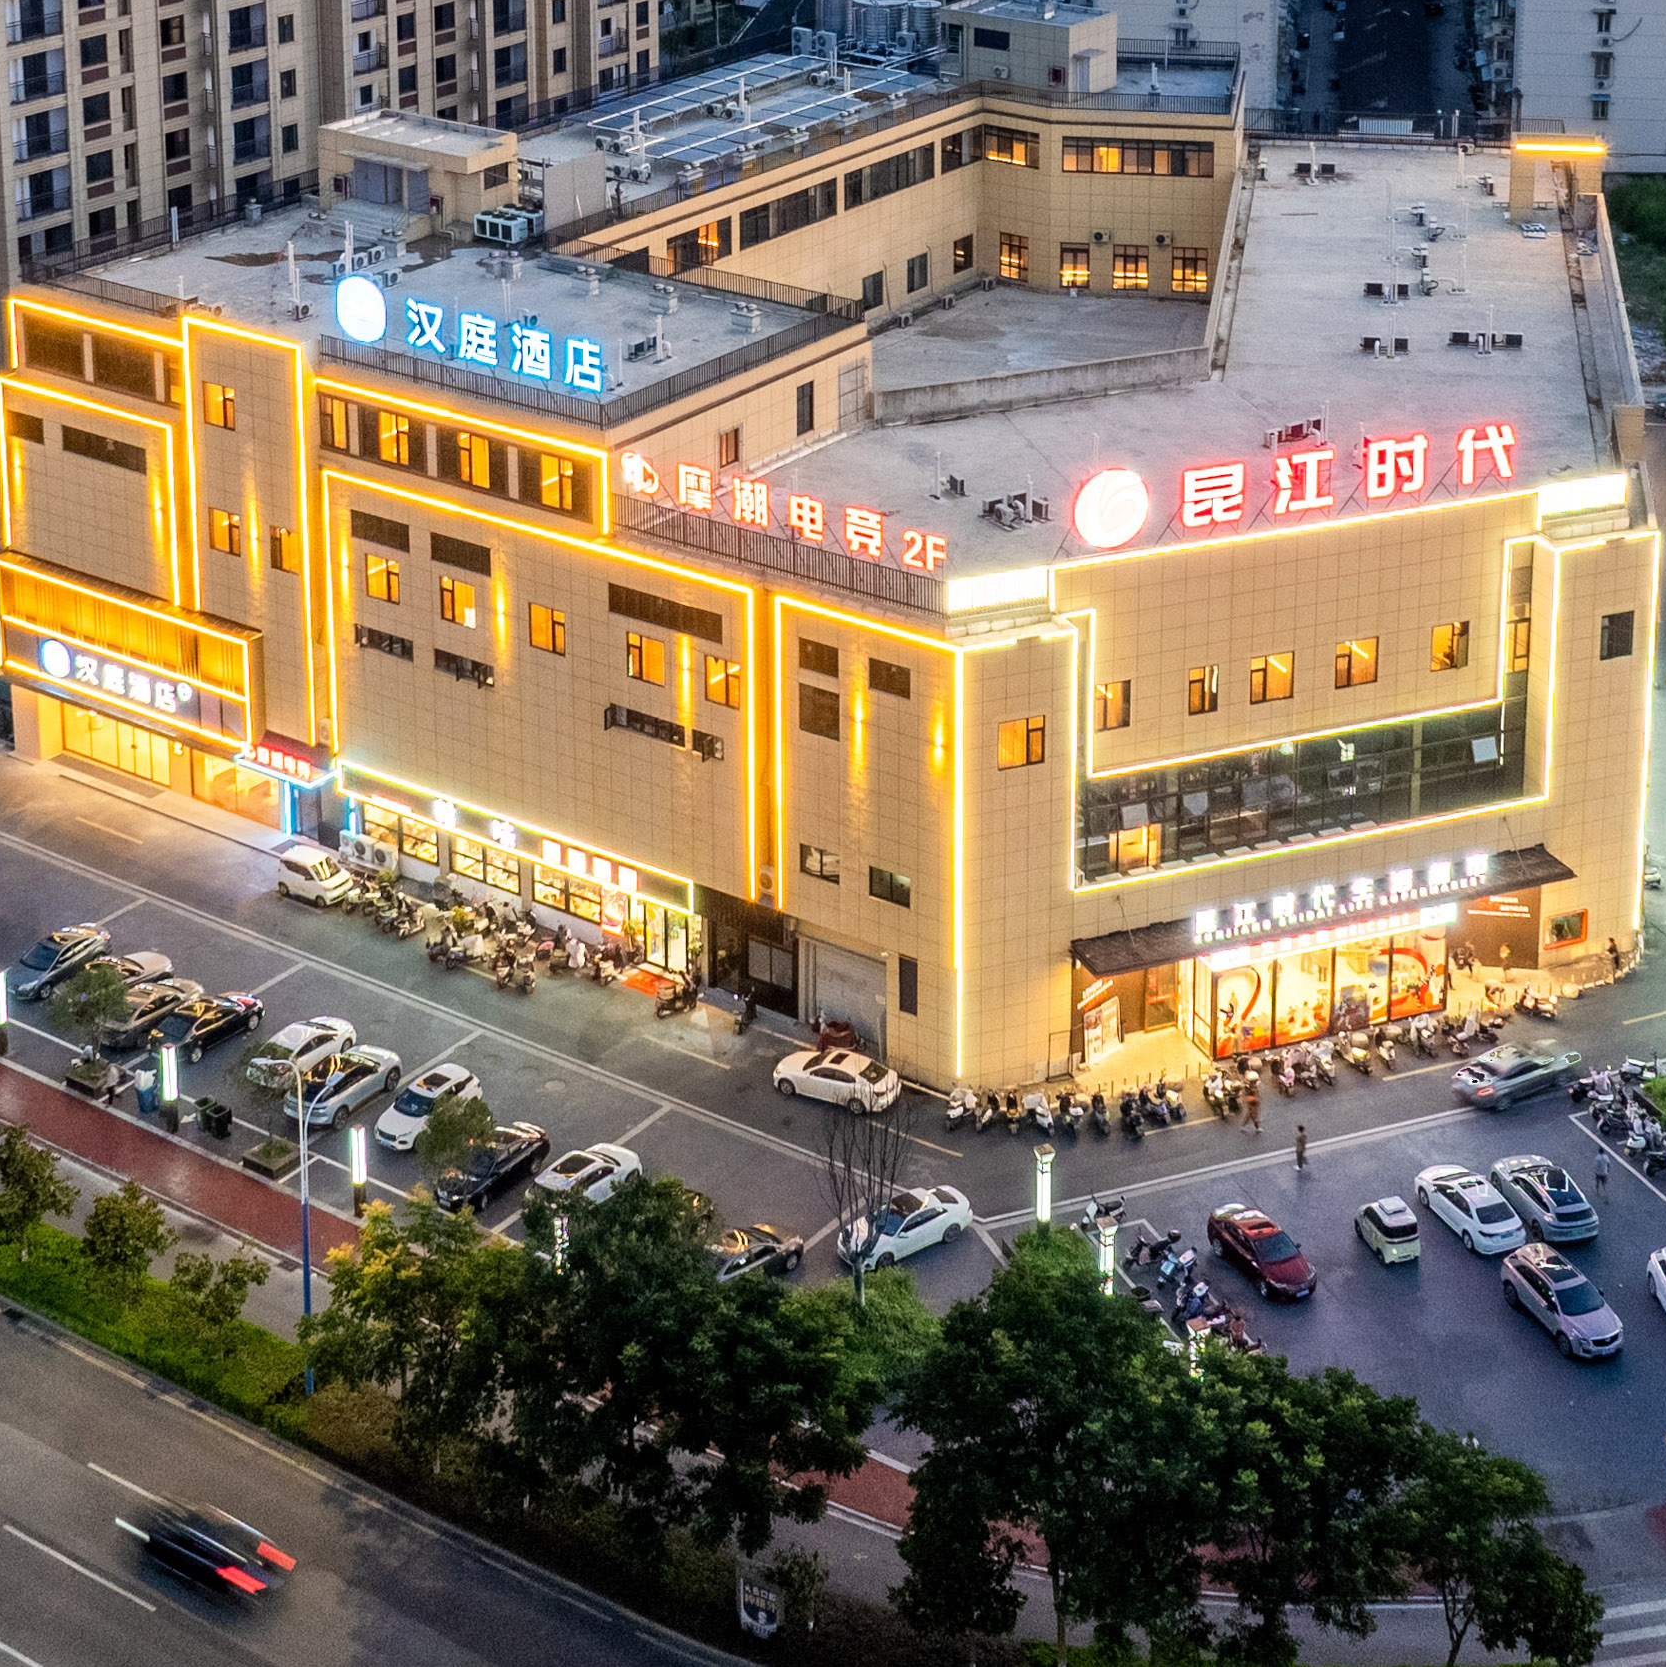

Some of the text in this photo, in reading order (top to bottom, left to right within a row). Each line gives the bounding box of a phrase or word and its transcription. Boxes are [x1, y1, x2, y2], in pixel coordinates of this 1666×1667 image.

[406, 297, 602, 393] 汉庭酒店
[677, 462, 948, 571] 摩潮电竞 2F
[1182, 424, 1517, 528] 昆江时代
[75, 654, 176, 713] 汉庭酒店
